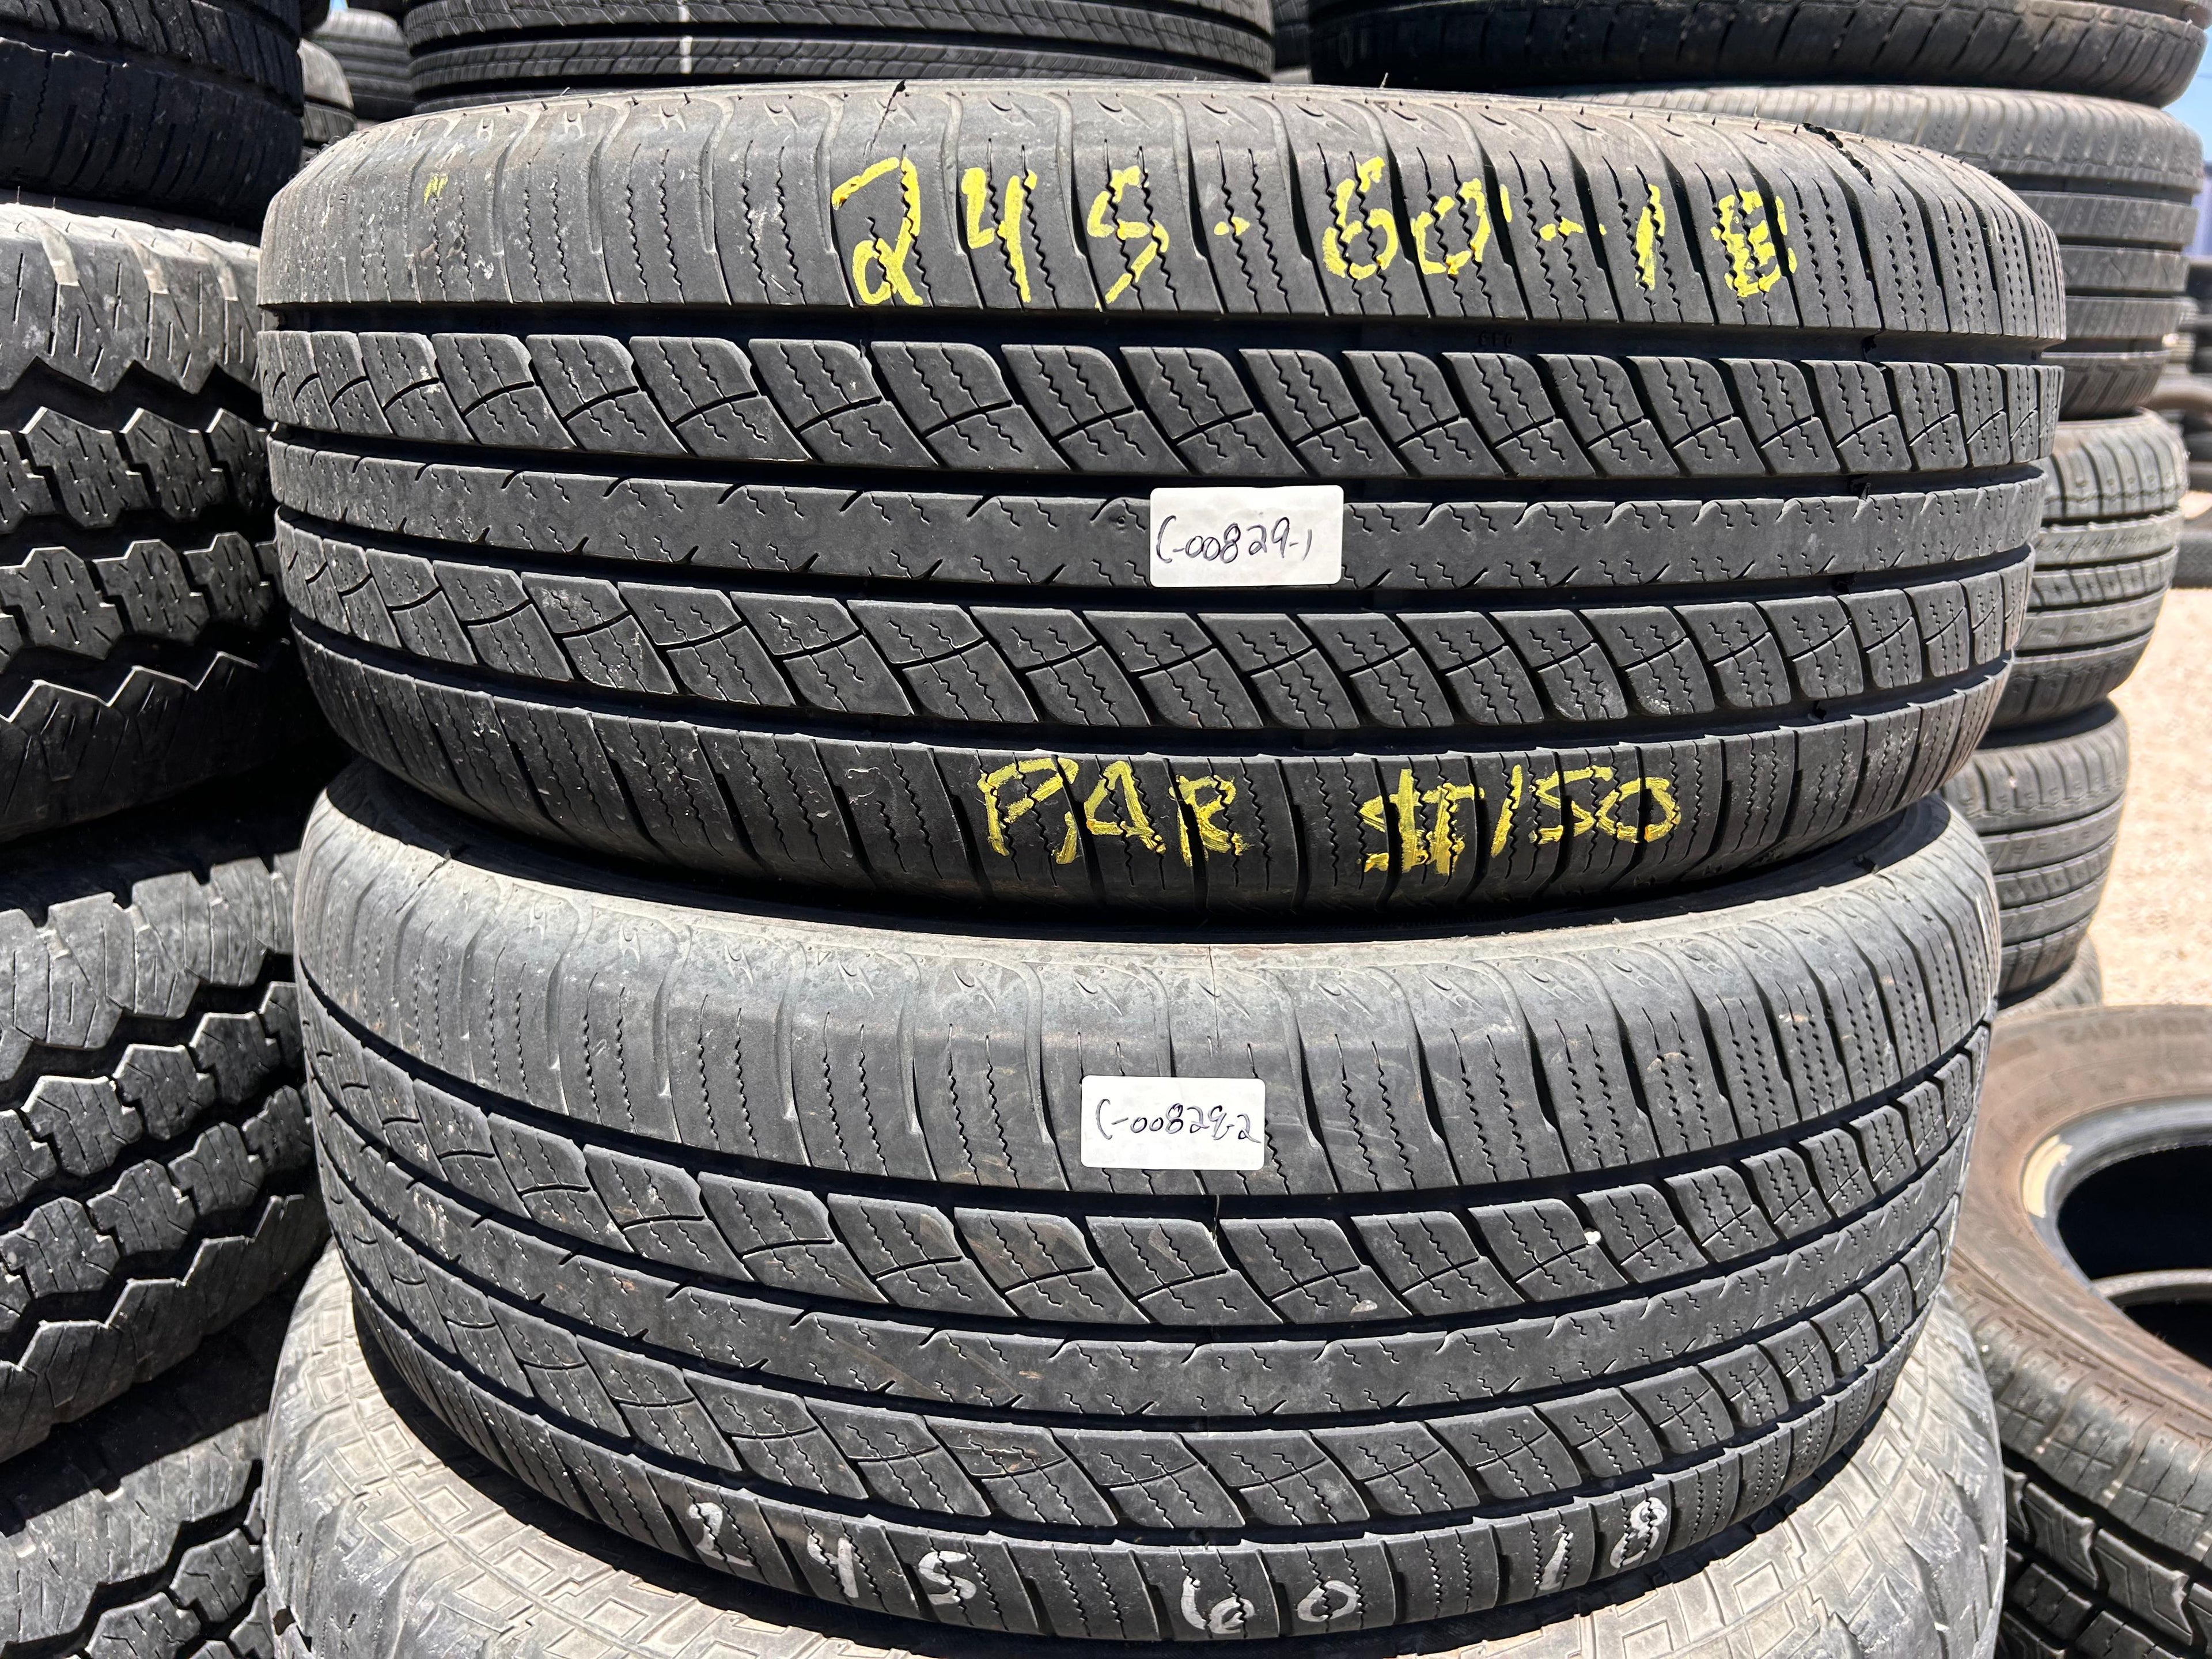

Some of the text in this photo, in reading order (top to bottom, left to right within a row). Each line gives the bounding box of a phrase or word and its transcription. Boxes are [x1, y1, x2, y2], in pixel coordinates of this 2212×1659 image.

[977, 757, 1254, 867] PAR
[688, 1497, 1669, 1634] 245 60 18
